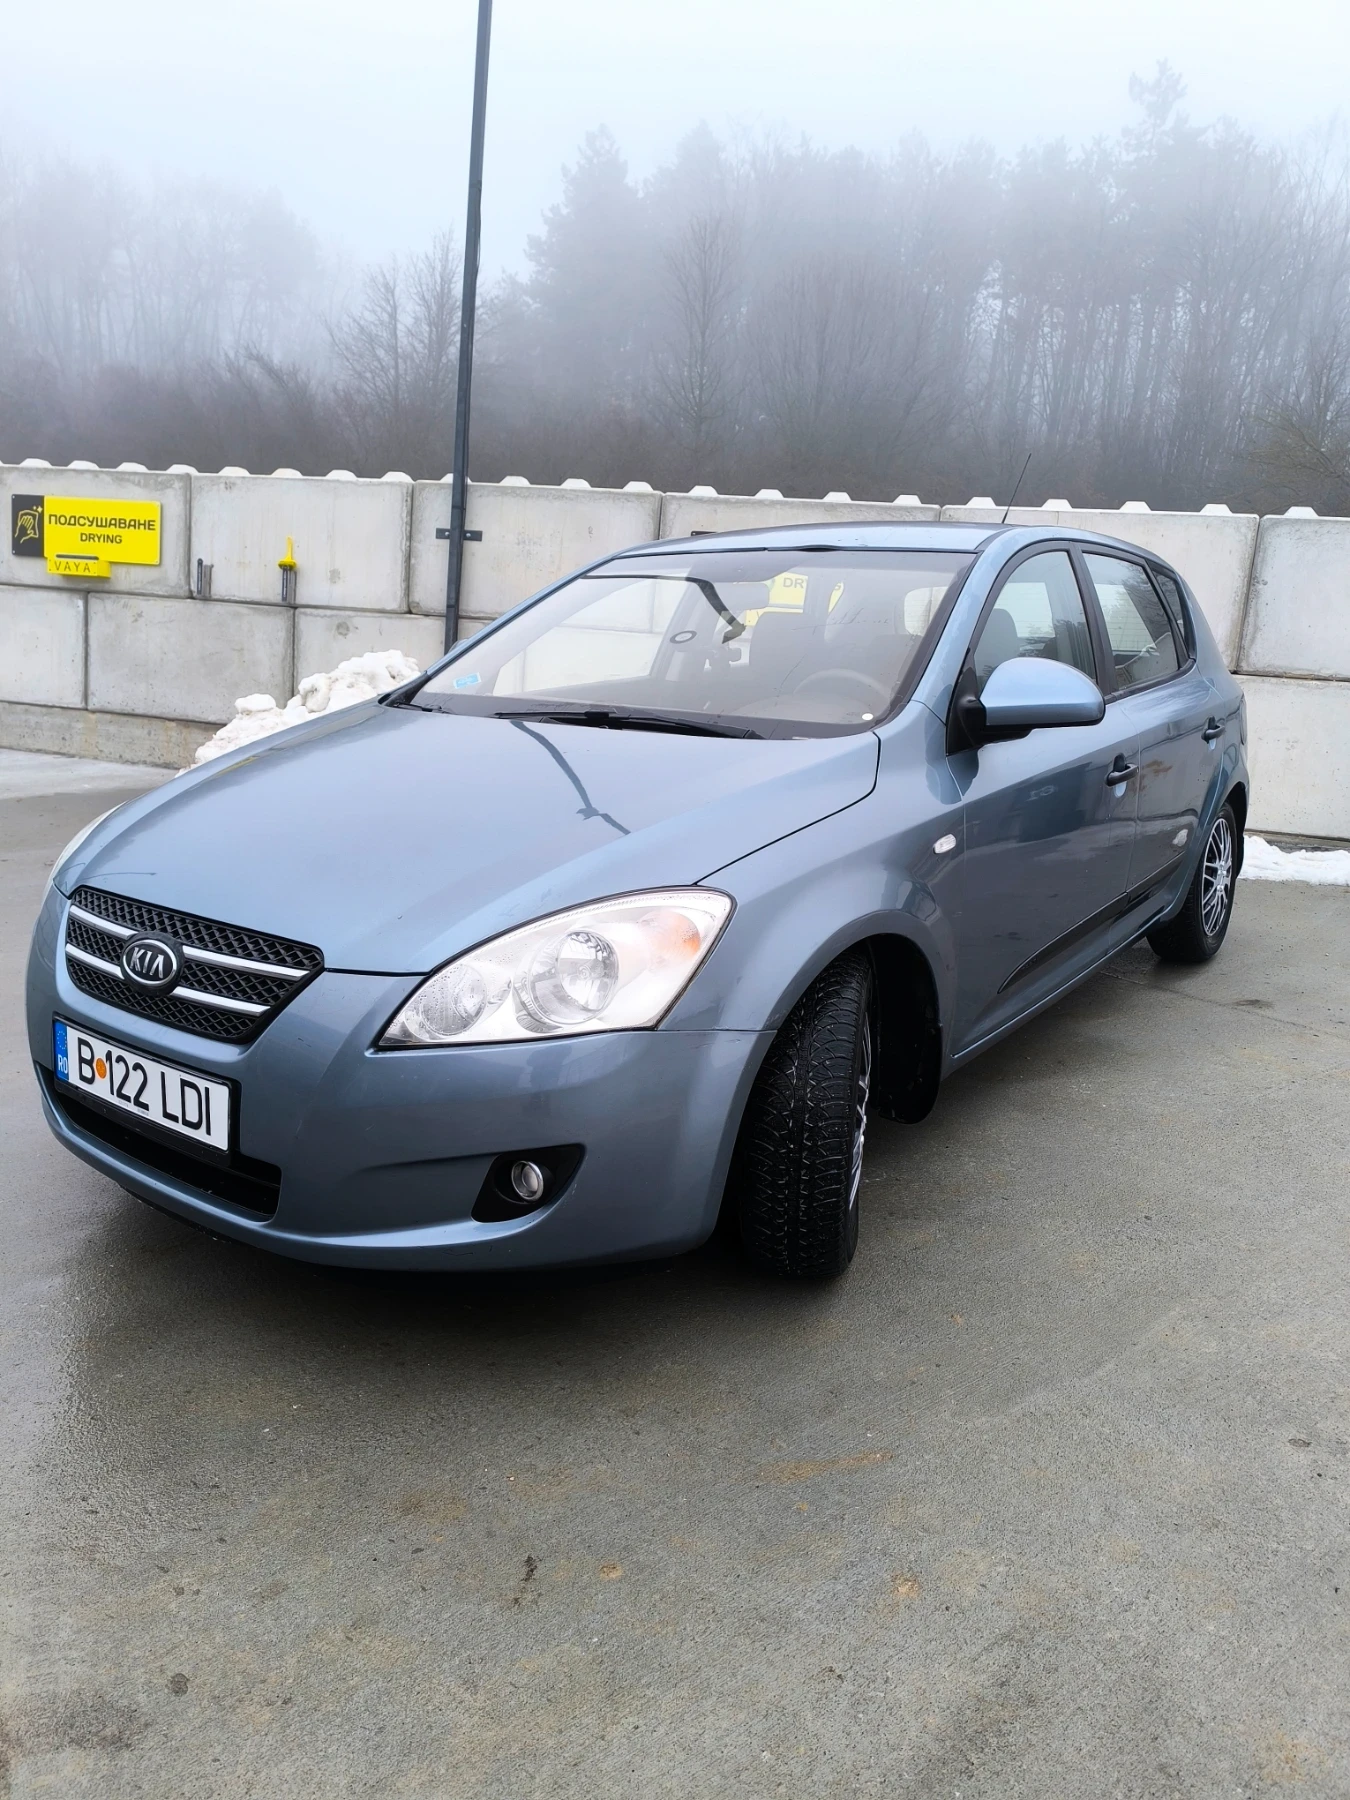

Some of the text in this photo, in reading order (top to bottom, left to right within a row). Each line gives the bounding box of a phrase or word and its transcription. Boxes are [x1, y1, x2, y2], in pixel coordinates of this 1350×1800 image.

[48, 513, 156, 531] ПОДСУШАВАНЕ
[80, 532, 123, 544] DRYING
[54, 561, 91, 573] VAYA
[129, 946, 165, 979] KIA
[57, 1053, 68, 1074] RO
[77, 1036, 212, 1136] B 122 LDI
